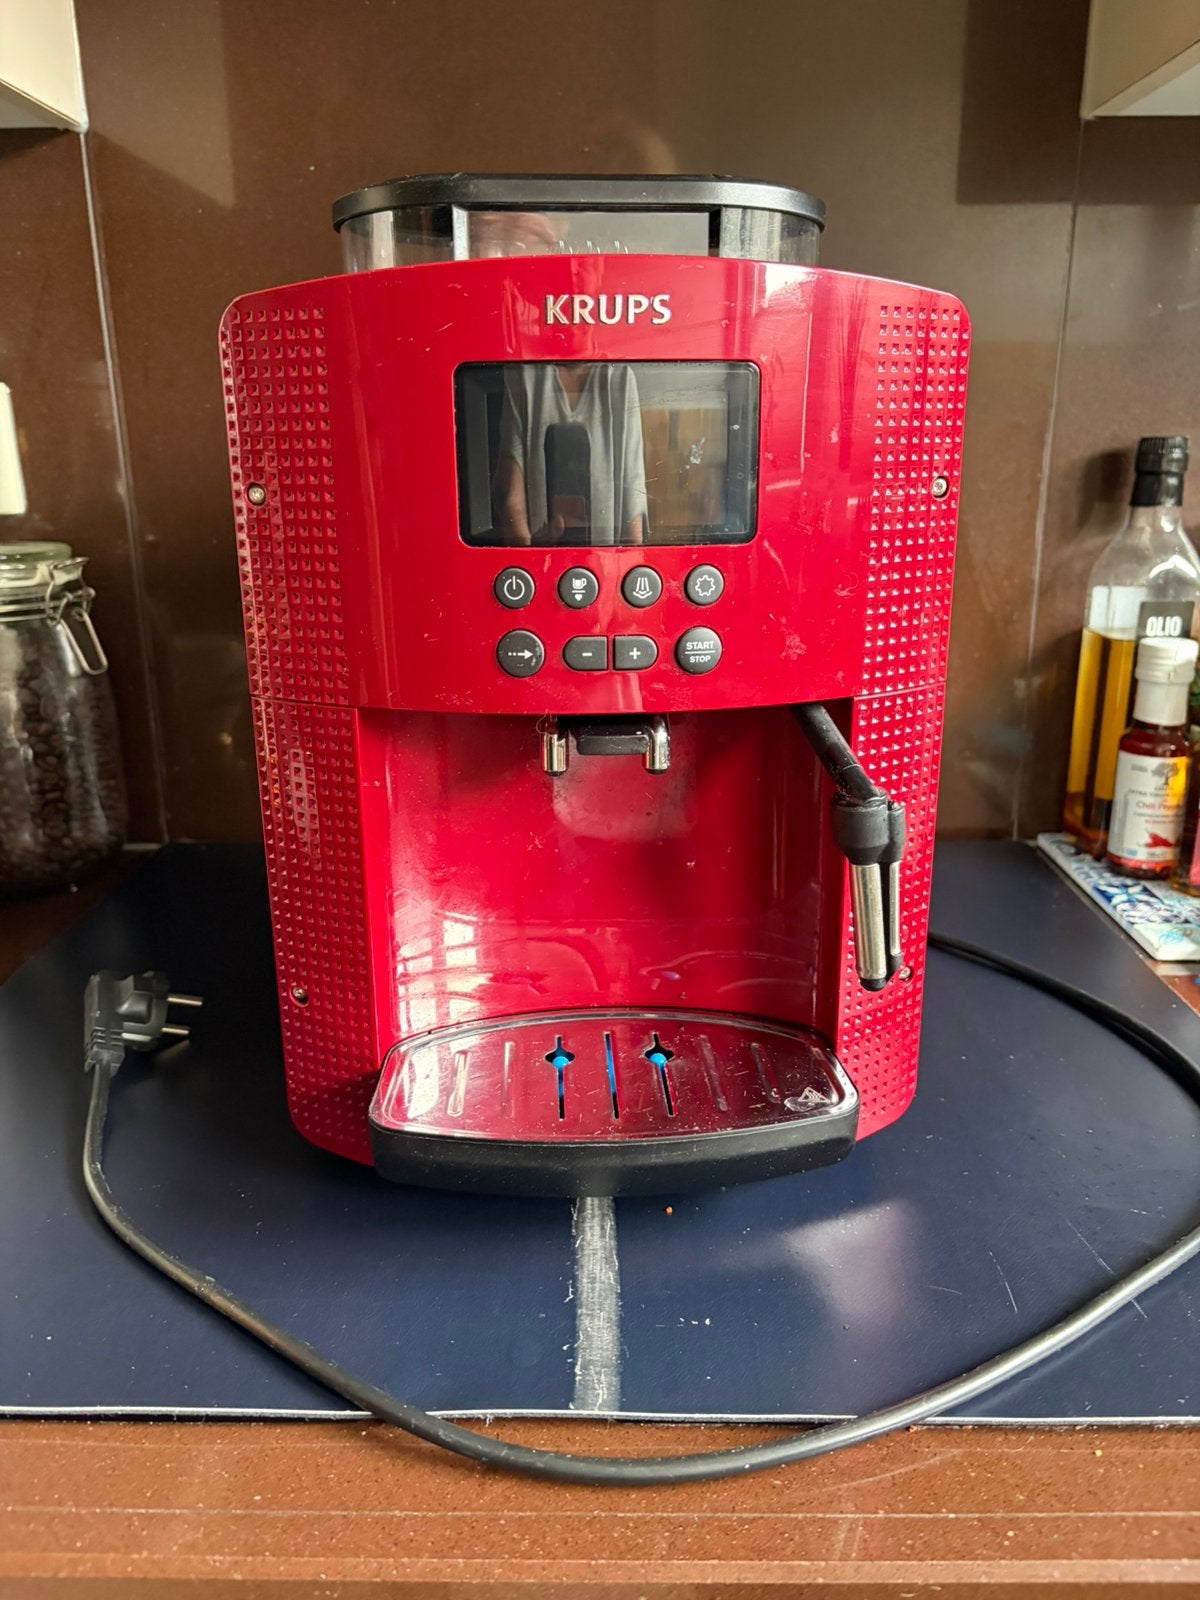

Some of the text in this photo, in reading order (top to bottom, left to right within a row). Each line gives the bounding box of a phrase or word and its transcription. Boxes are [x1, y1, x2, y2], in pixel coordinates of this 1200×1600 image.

[545, 294, 672, 325] KRUPS
[1146, 615, 1182, 637] OLIO
[686, 641, 714, 650] START
[689, 655, 711, 663] STOP
